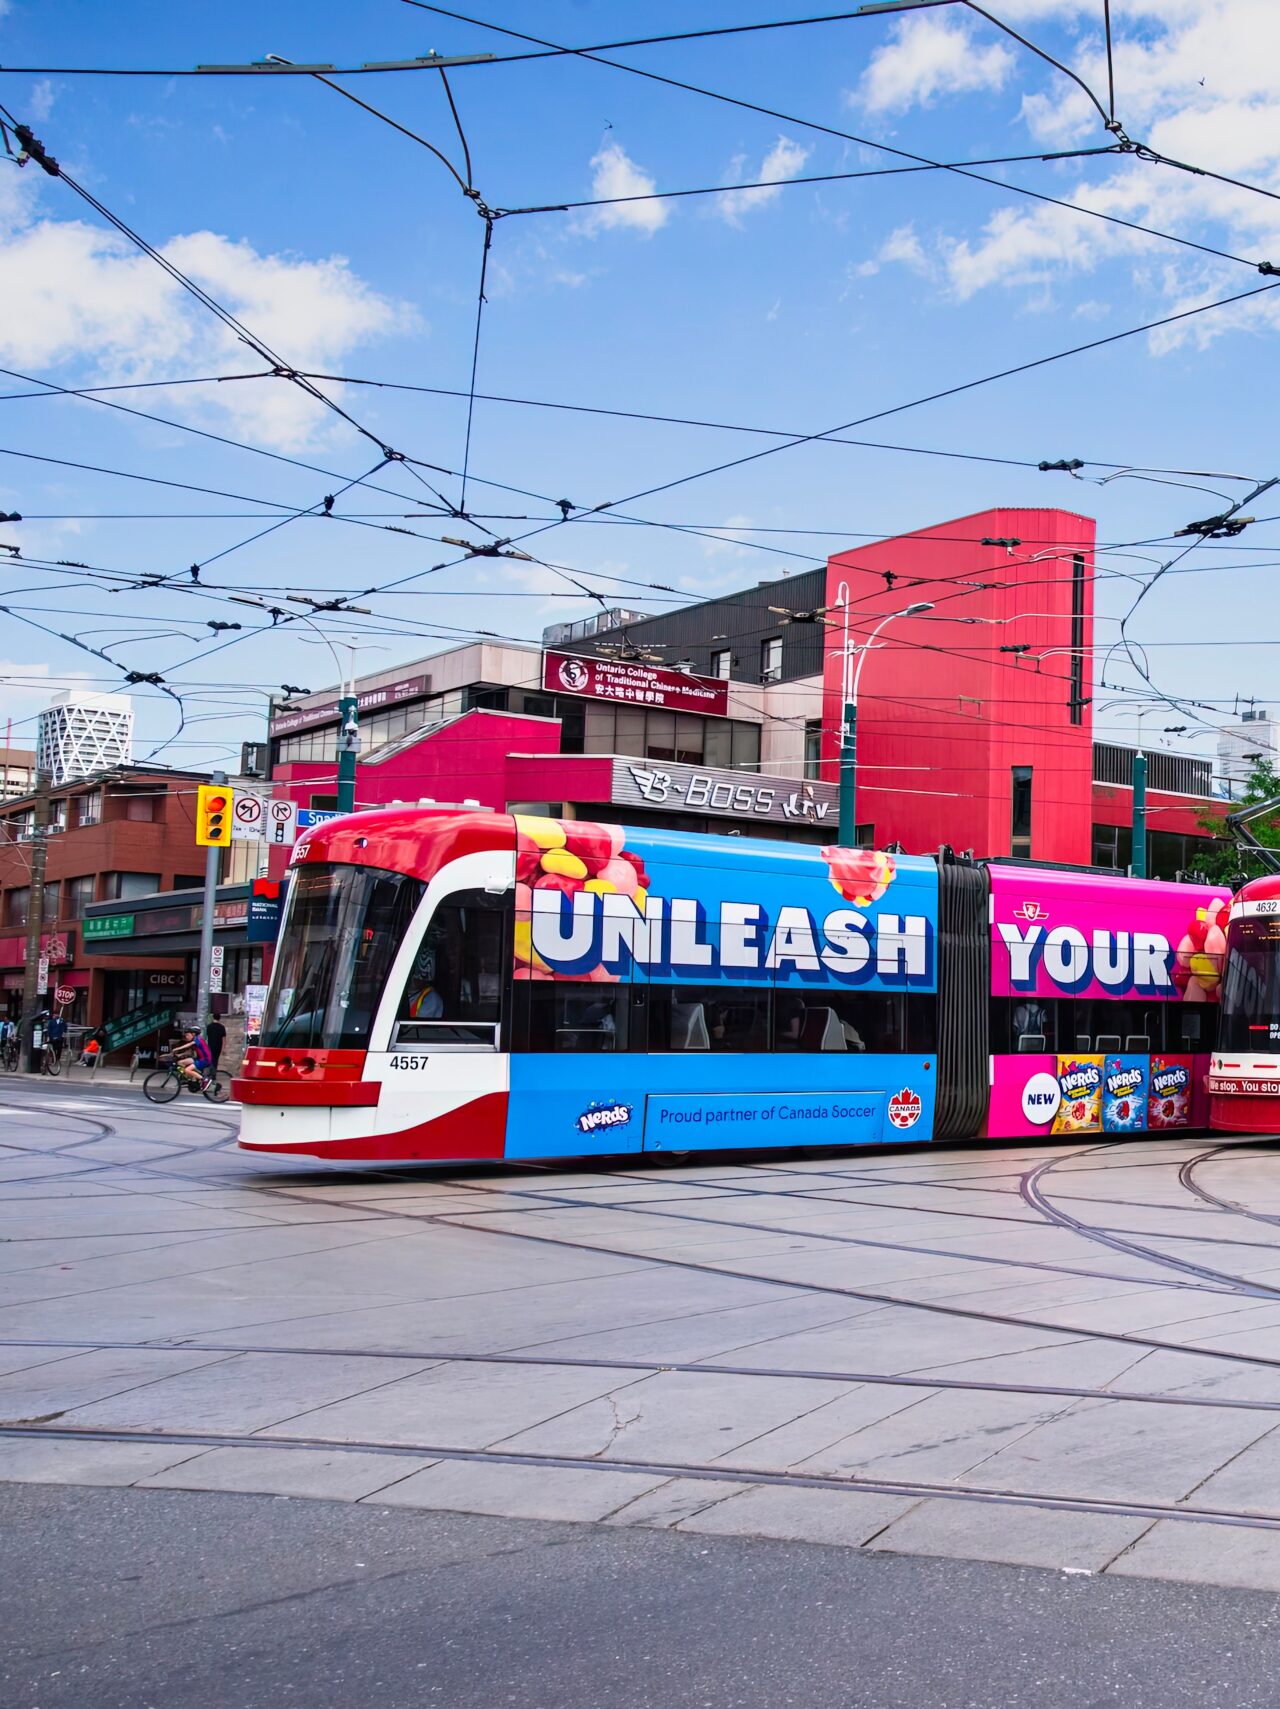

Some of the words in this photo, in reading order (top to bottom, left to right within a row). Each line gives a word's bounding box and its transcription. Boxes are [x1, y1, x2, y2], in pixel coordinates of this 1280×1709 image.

[596, 663, 626, 674] Ontario
[627, 668, 657, 680] College
[595, 673, 604, 681] of
[606, 674, 649, 688] Traditional
[650, 681, 680, 693] Chinese
[1256, 901, 1277, 912] 4632
[531, 887, 928, 979] UNLEASH
[996, 922, 1174, 990] YOUR
[150, 974, 175, 985] CIBC
[57, 990, 75, 999] STOP
[390, 1056, 428, 1070] 4557
[1219, 1081, 1239, 1092] stop.
[1241, 1081, 1259, 1091] You
[1027, 1093, 1055, 1105] NEW
[661, 1108, 702, 1124] Proud
[705, 1108, 757, 1125] partner
[762, 1106, 776, 1120] of
[778, 1105, 829, 1120] Canada
[831, 1105, 875, 1118] Soccer
